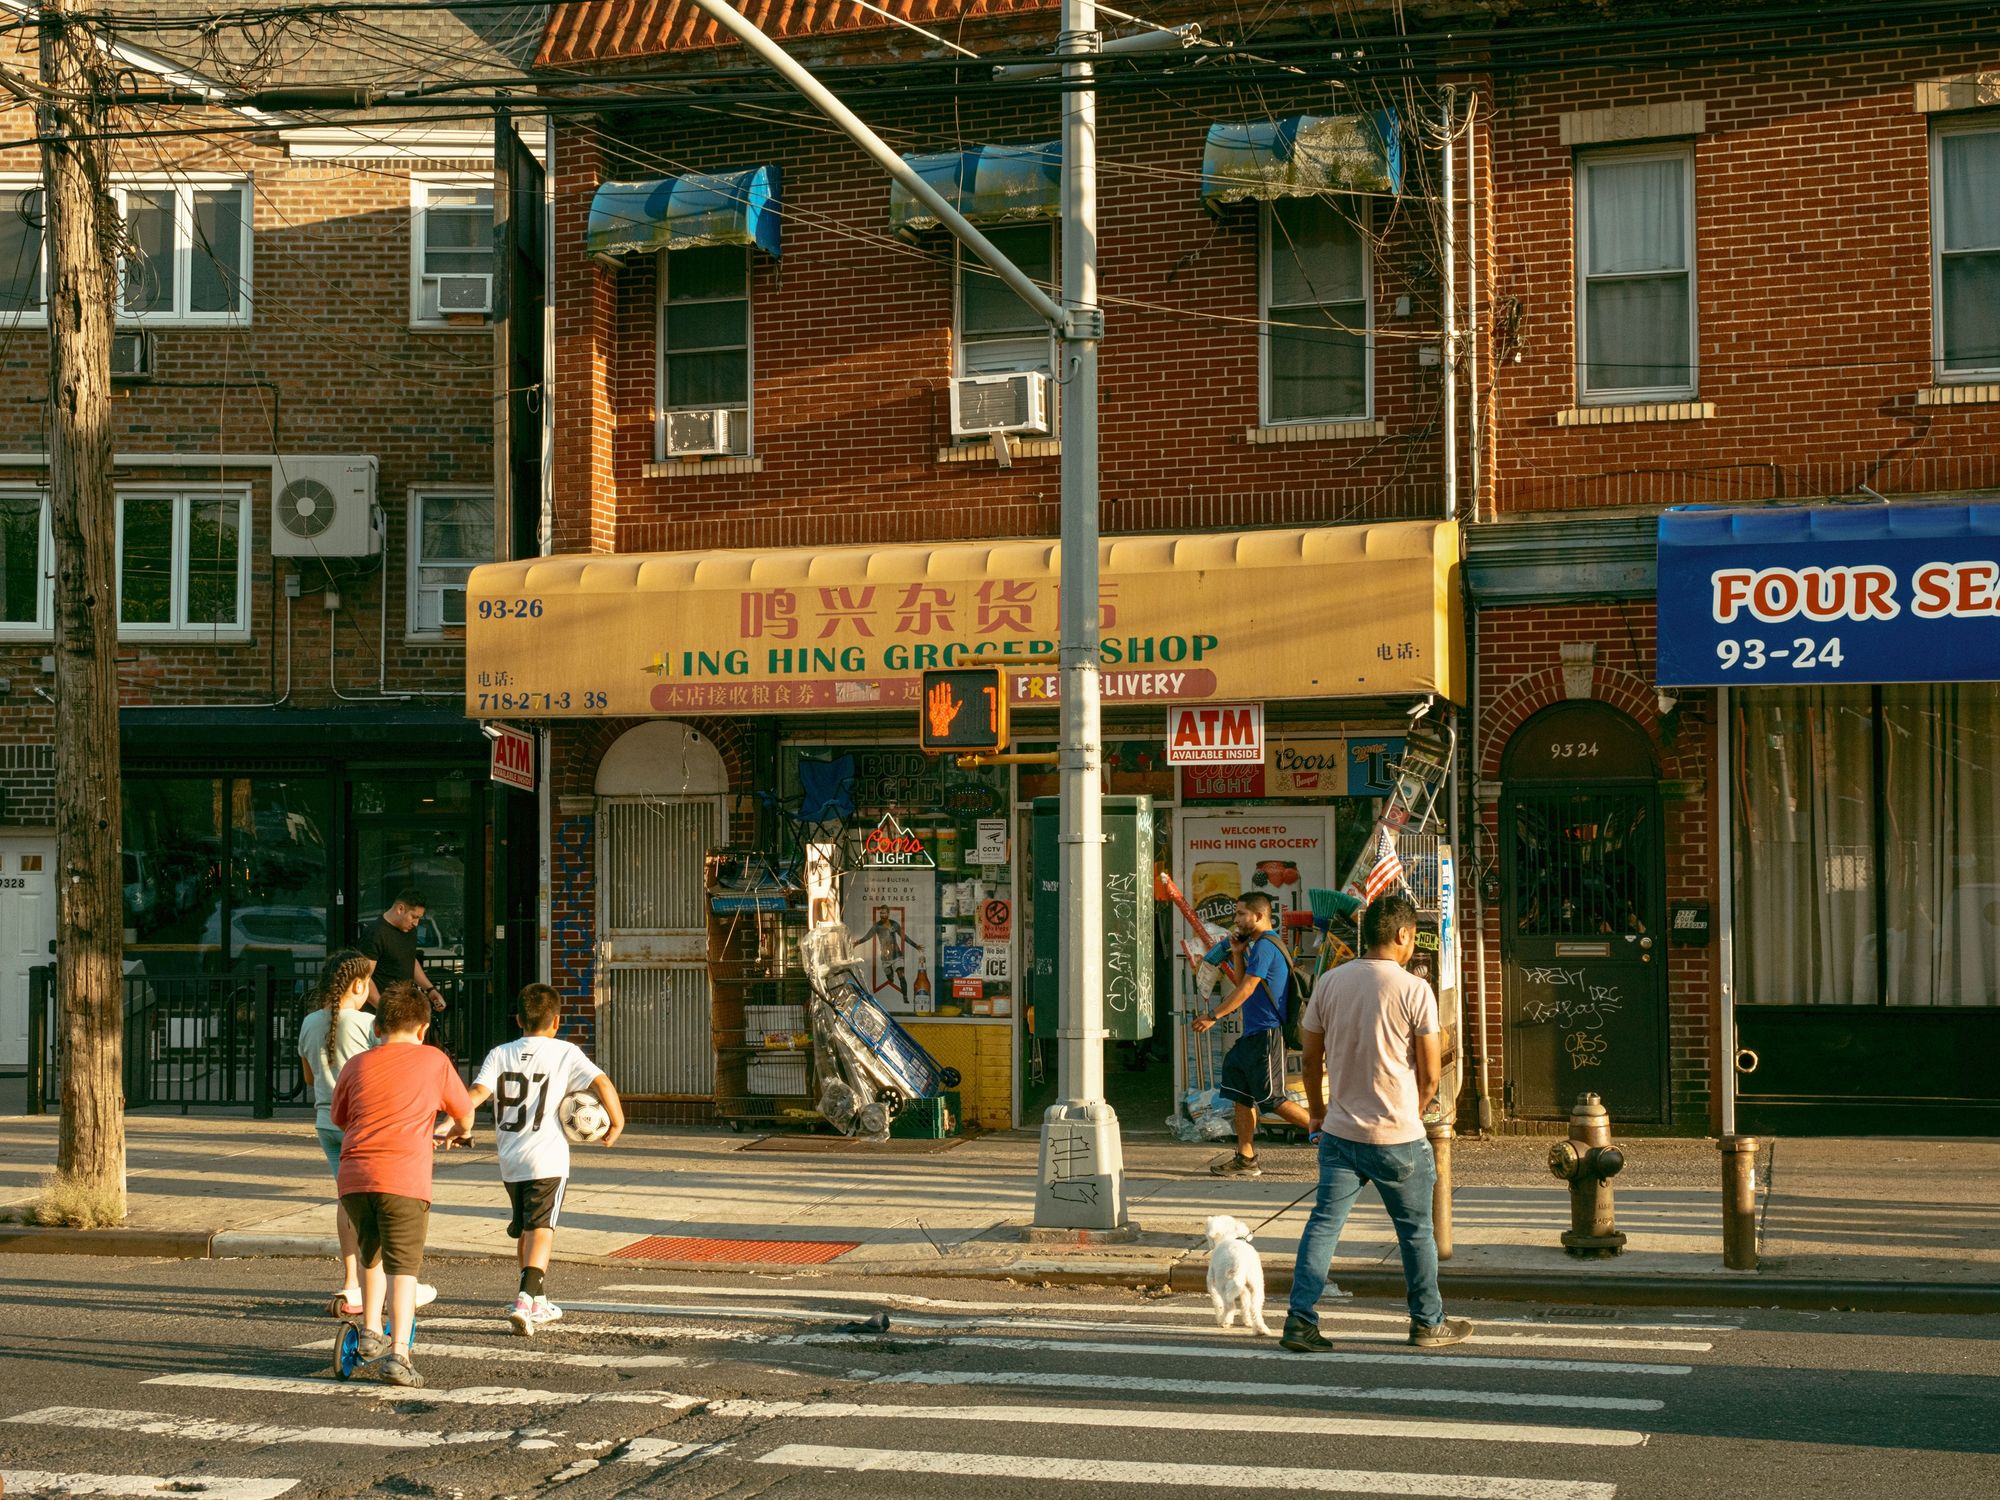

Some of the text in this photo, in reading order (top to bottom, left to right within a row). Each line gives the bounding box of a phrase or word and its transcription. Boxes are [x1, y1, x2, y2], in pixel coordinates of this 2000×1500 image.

[1713, 562, 2000, 622] FOUR SE
[478, 599, 544, 619] 93-26
[768, 647, 866, 674] HING
[883, 639, 1061, 670] GROCER
[1100, 635, 1218, 664] SHOP
[1716, 637, 1844, 669] 93-24
[1018, 675, 1061, 698] FRE
[1174, 709, 1255, 747] ATM
[495, 735, 531, 774] ATM
[861, 754, 926, 777] BUD
[1172, 750, 1258, 760] AVAILABLE INSIDE
[1275, 748, 1337, 770] Coors
[1196, 778, 1252, 793] LIGHT
[866, 828, 924, 853] Coors
[1221, 826, 1286, 834] WELCOME TO
[1190, 838, 1319, 849] HING HING GROCERY
[875, 852, 912, 864] LIGHT
[0, 878, 25, 889] 328
[986, 959, 1007, 976] ICE
